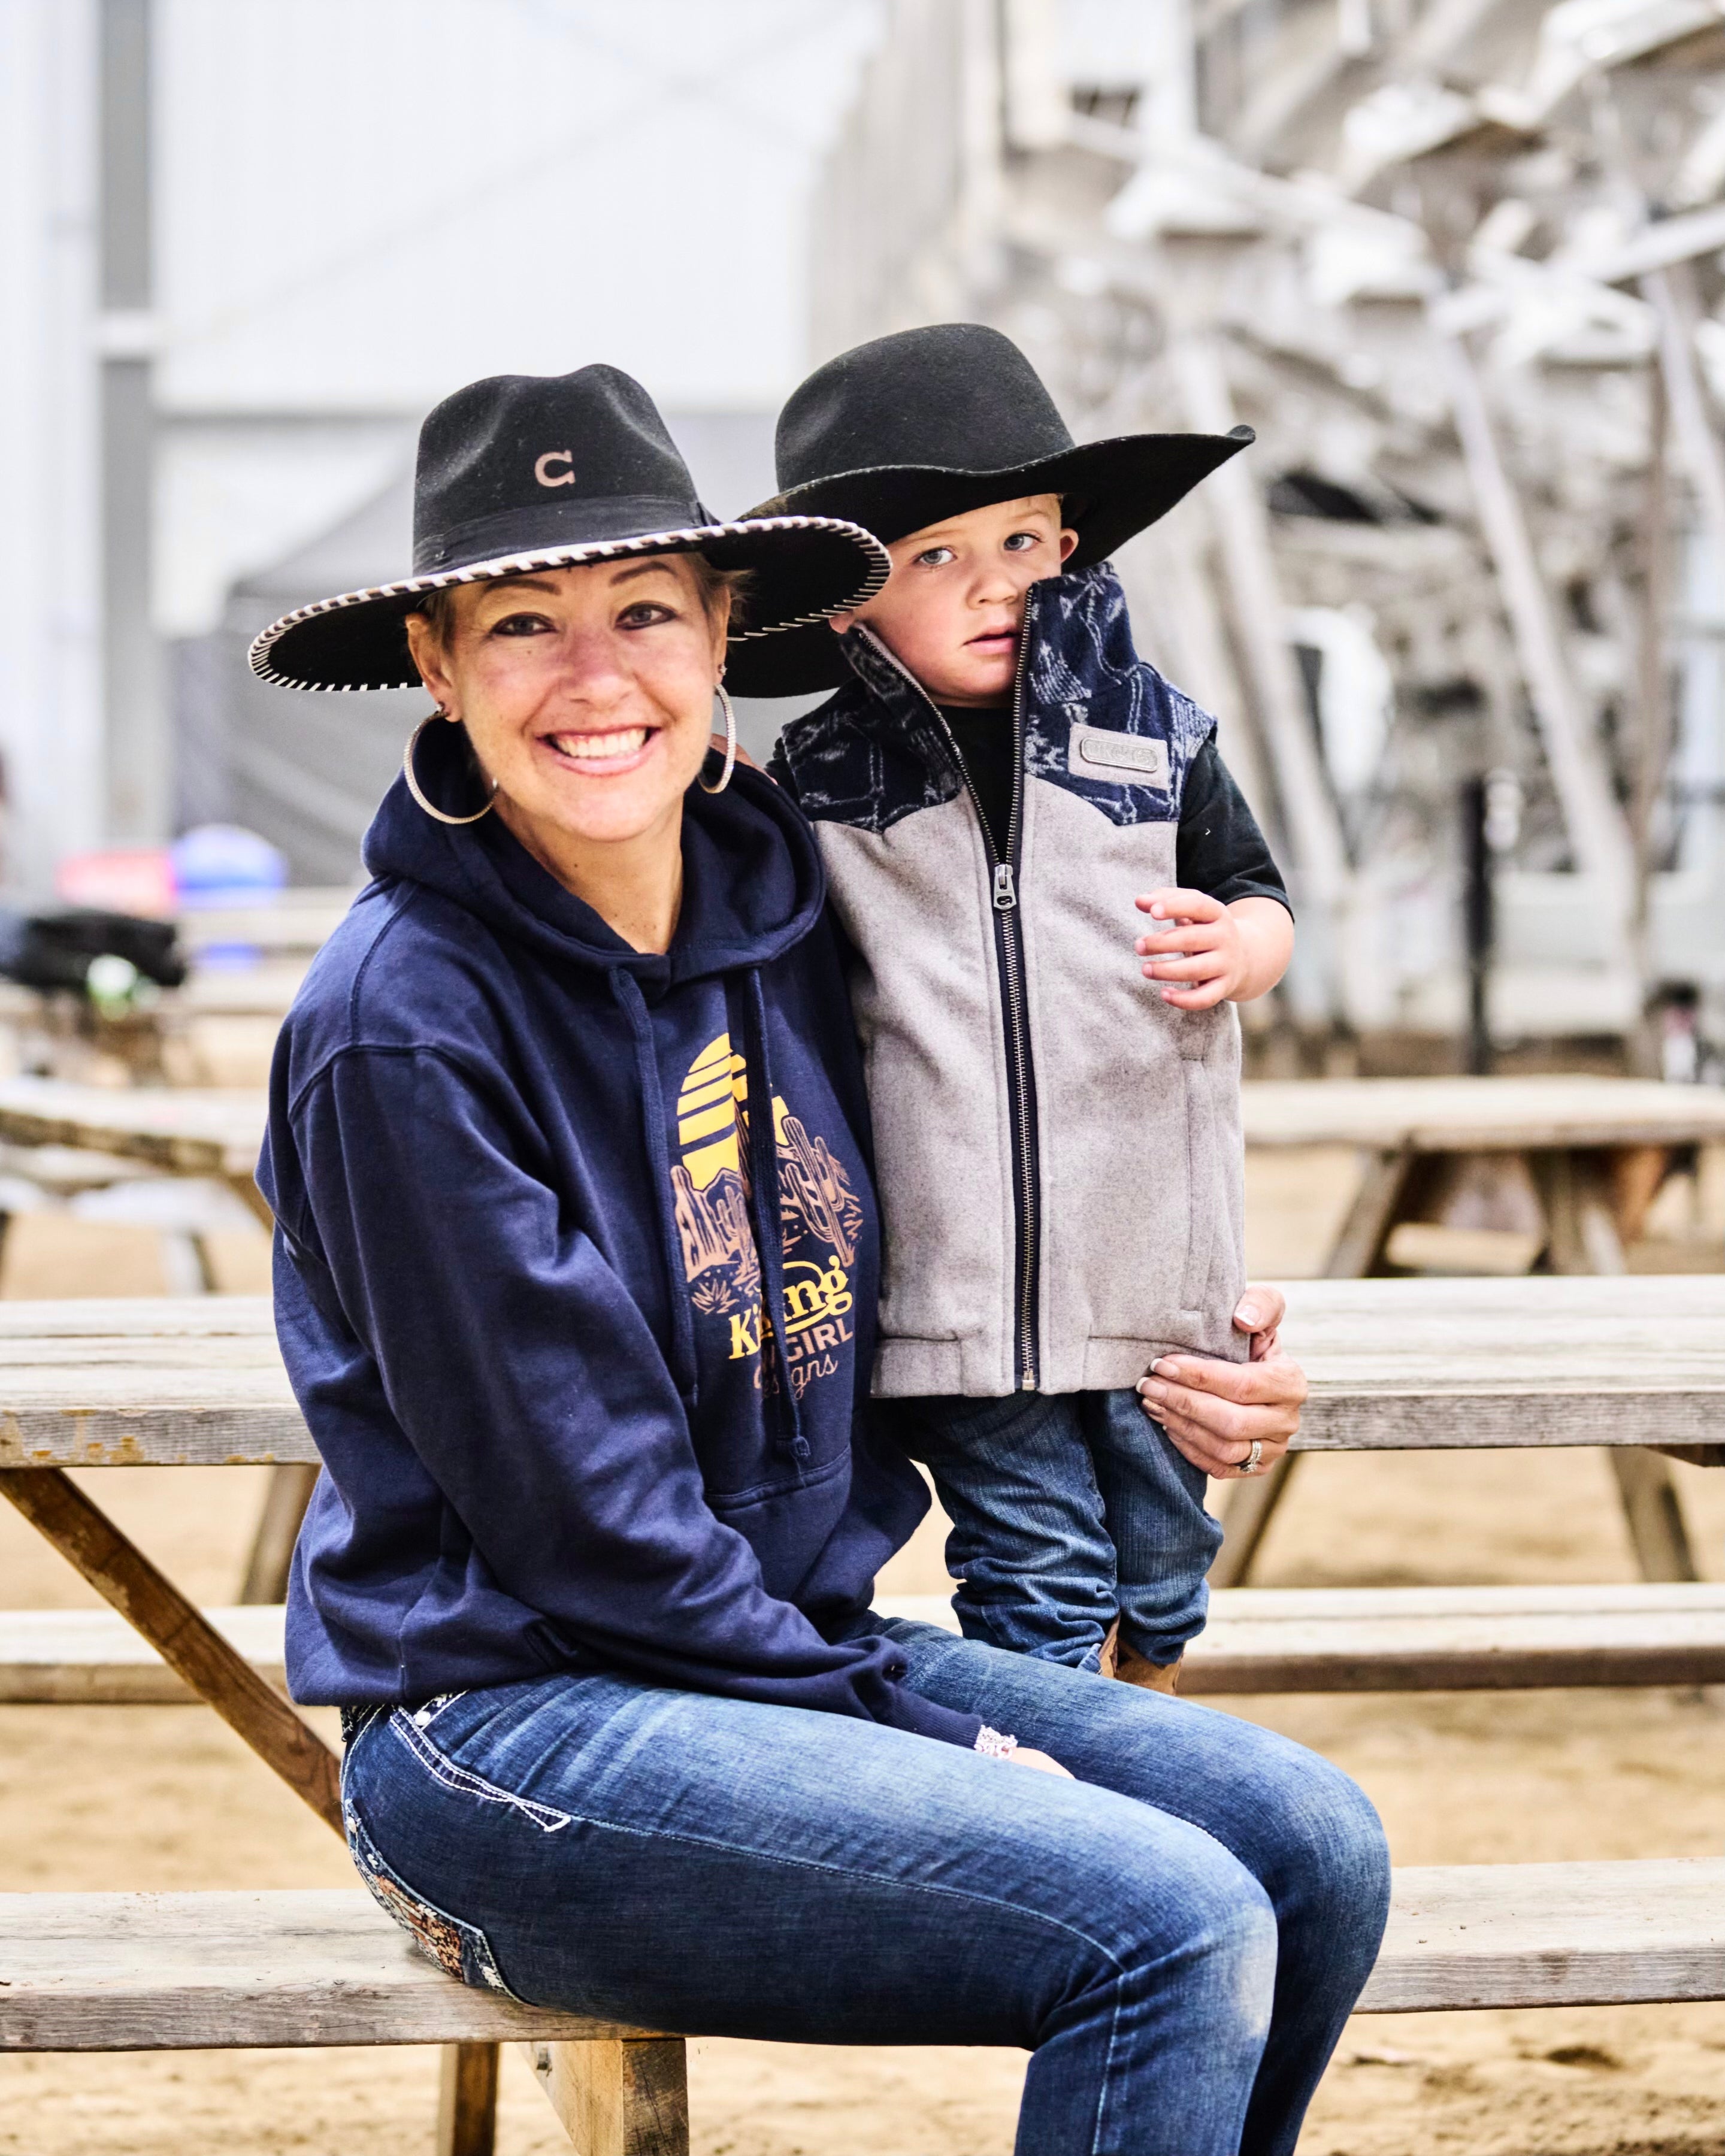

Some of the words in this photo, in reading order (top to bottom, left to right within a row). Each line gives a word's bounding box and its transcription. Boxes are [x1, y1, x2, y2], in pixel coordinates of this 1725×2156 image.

[534, 449, 576, 487] C
[728, 1254, 854, 1359] King
[762, 1318, 854, 1373] GIRL
